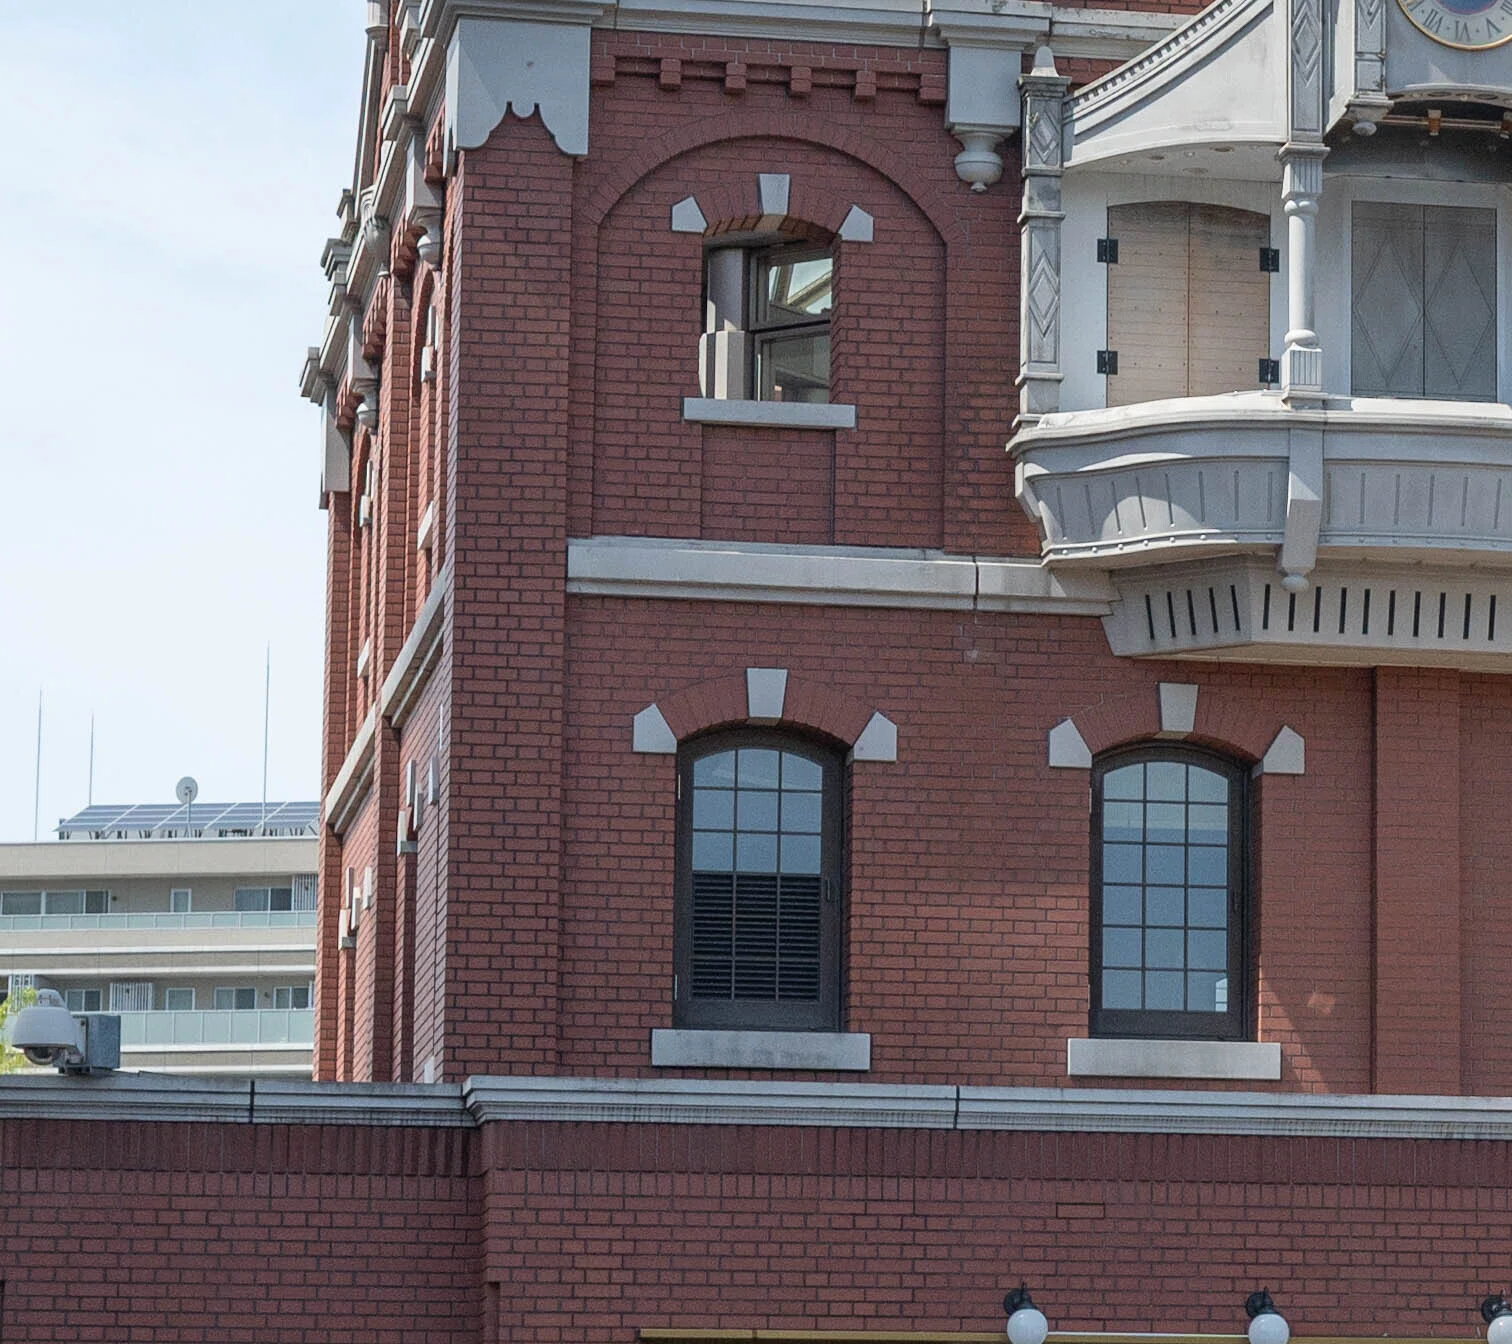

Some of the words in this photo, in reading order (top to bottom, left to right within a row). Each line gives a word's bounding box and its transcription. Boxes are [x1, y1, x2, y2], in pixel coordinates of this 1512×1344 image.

[1422, 9, 1444, 33] VII
[1455, 20, 1471, 42] VI
[1486, 17, 1502, 38] V
